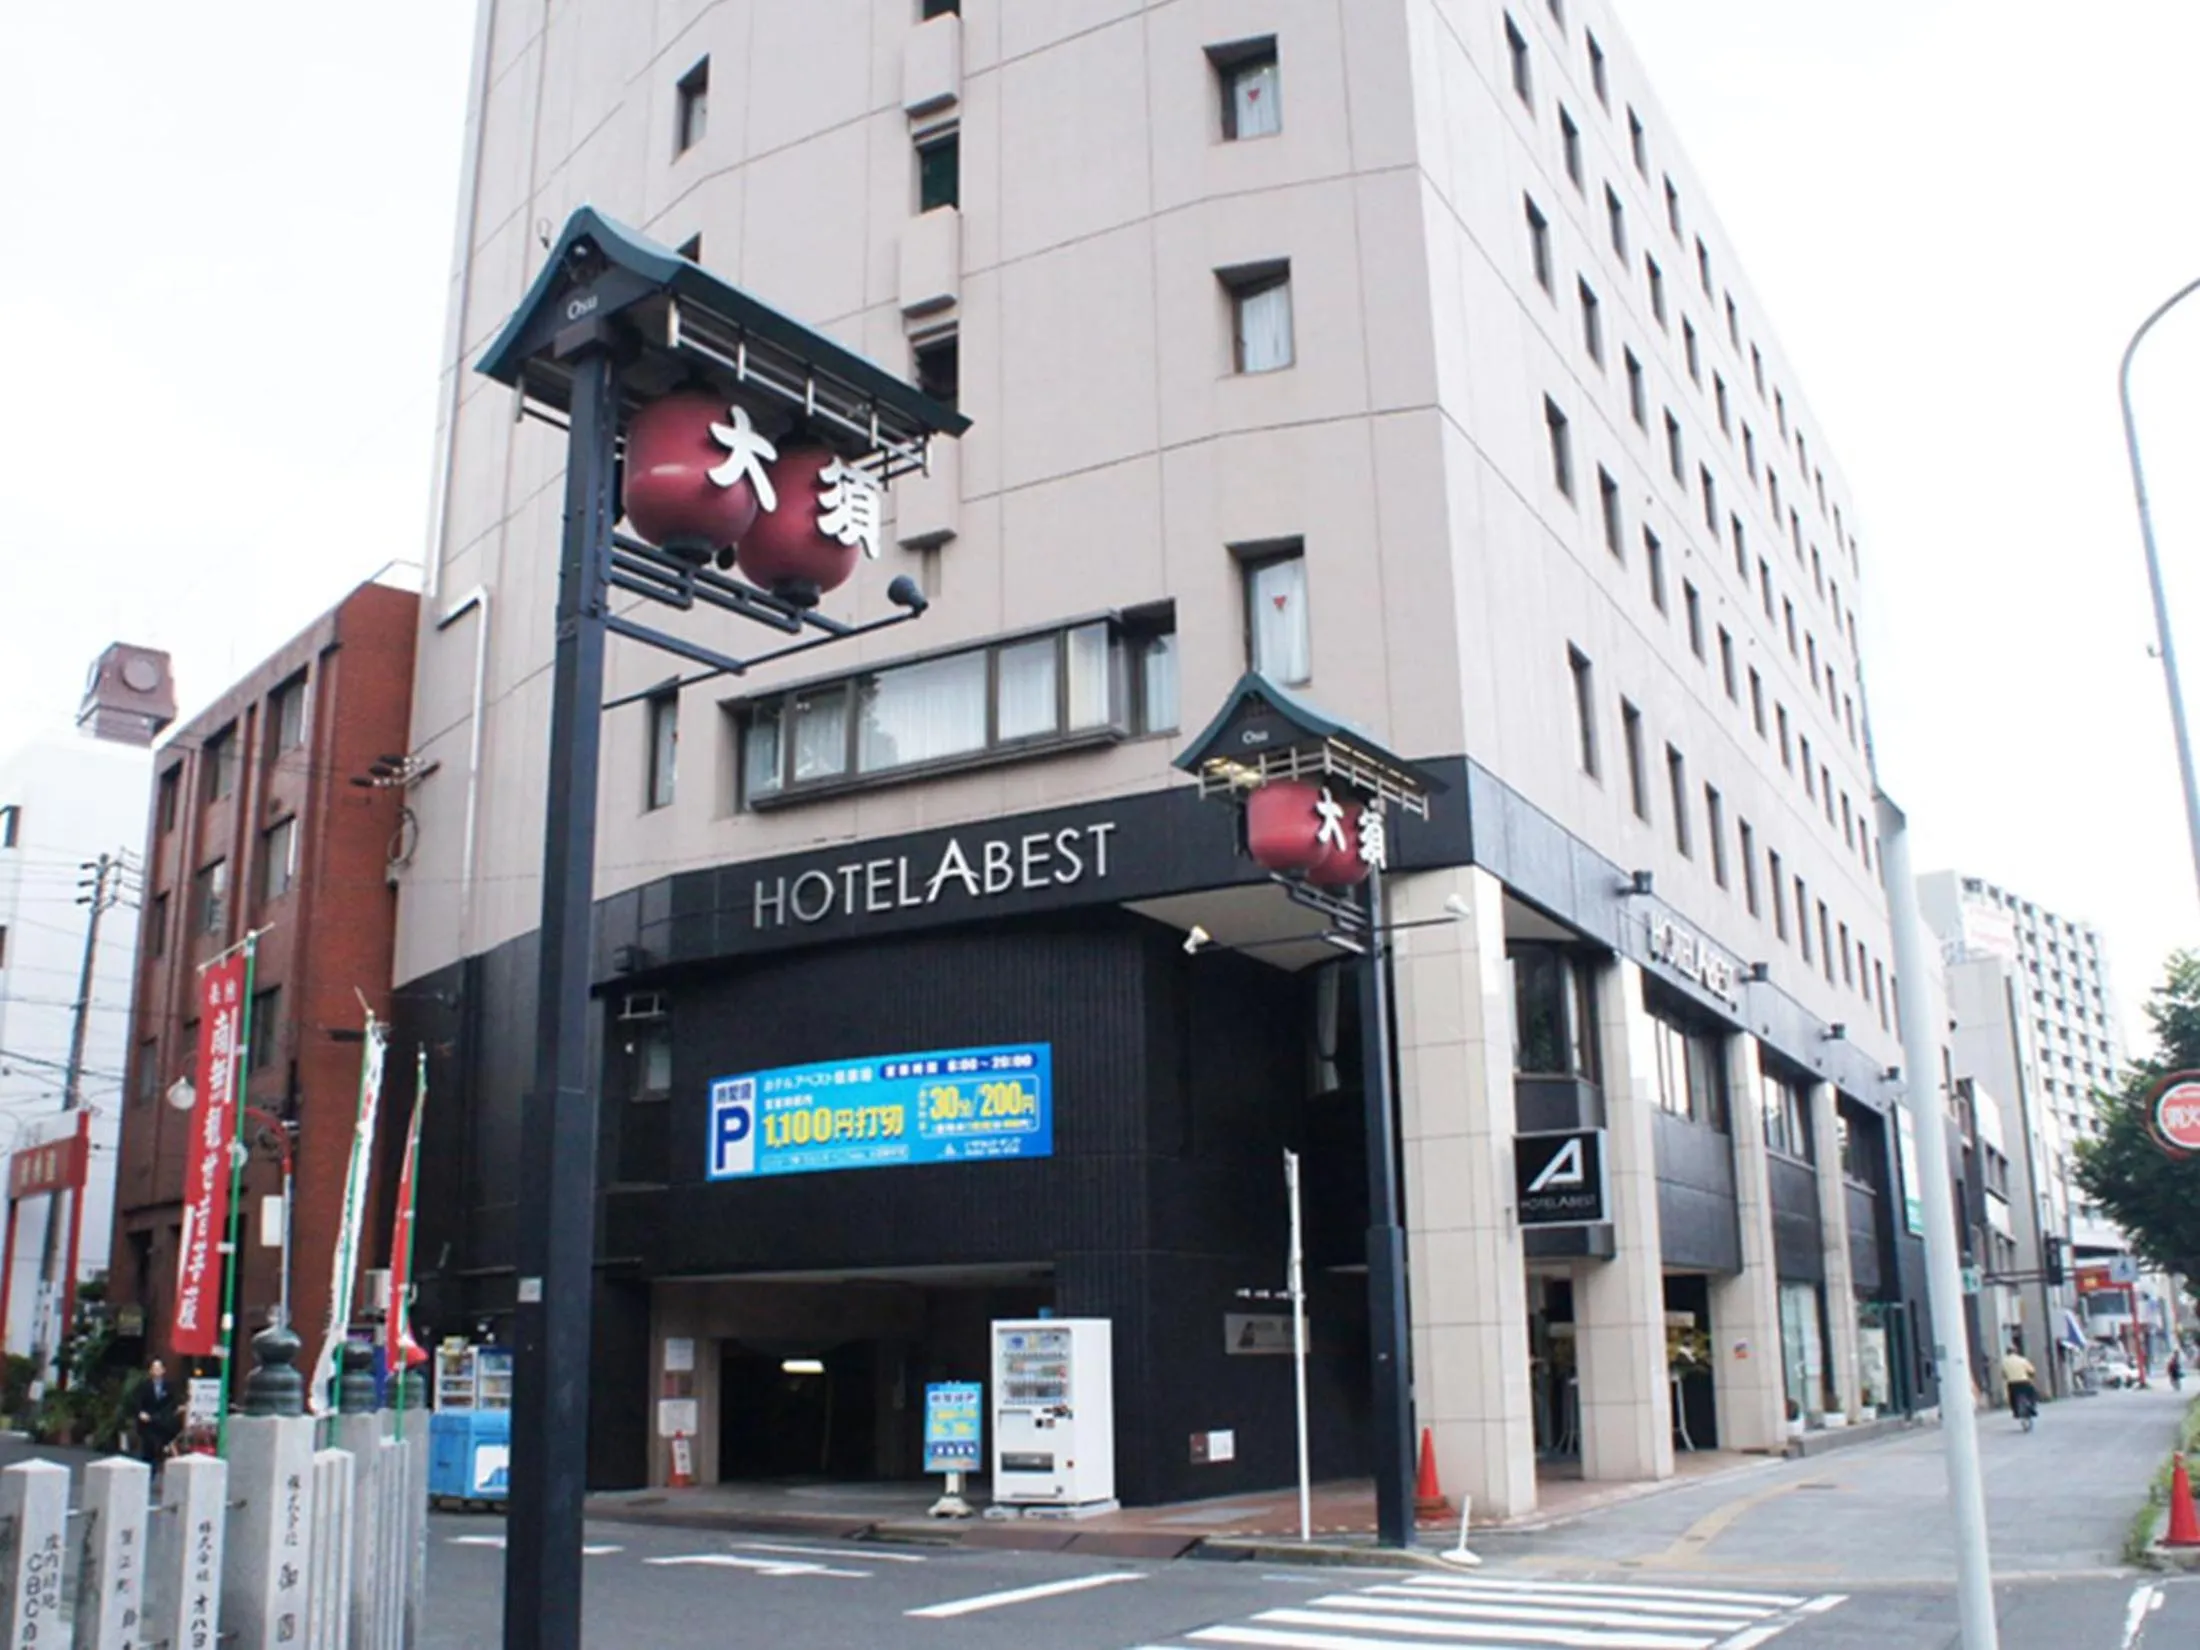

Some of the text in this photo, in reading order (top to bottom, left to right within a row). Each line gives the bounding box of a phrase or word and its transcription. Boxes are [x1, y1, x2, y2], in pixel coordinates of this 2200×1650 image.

[566, 296, 598, 320] Osu
[707, 404, 881, 559] 大須
[1242, 730, 1269, 745] Osu
[1316, 786, 1387, 870] 大須
[715, 1105, 750, 1170] P
